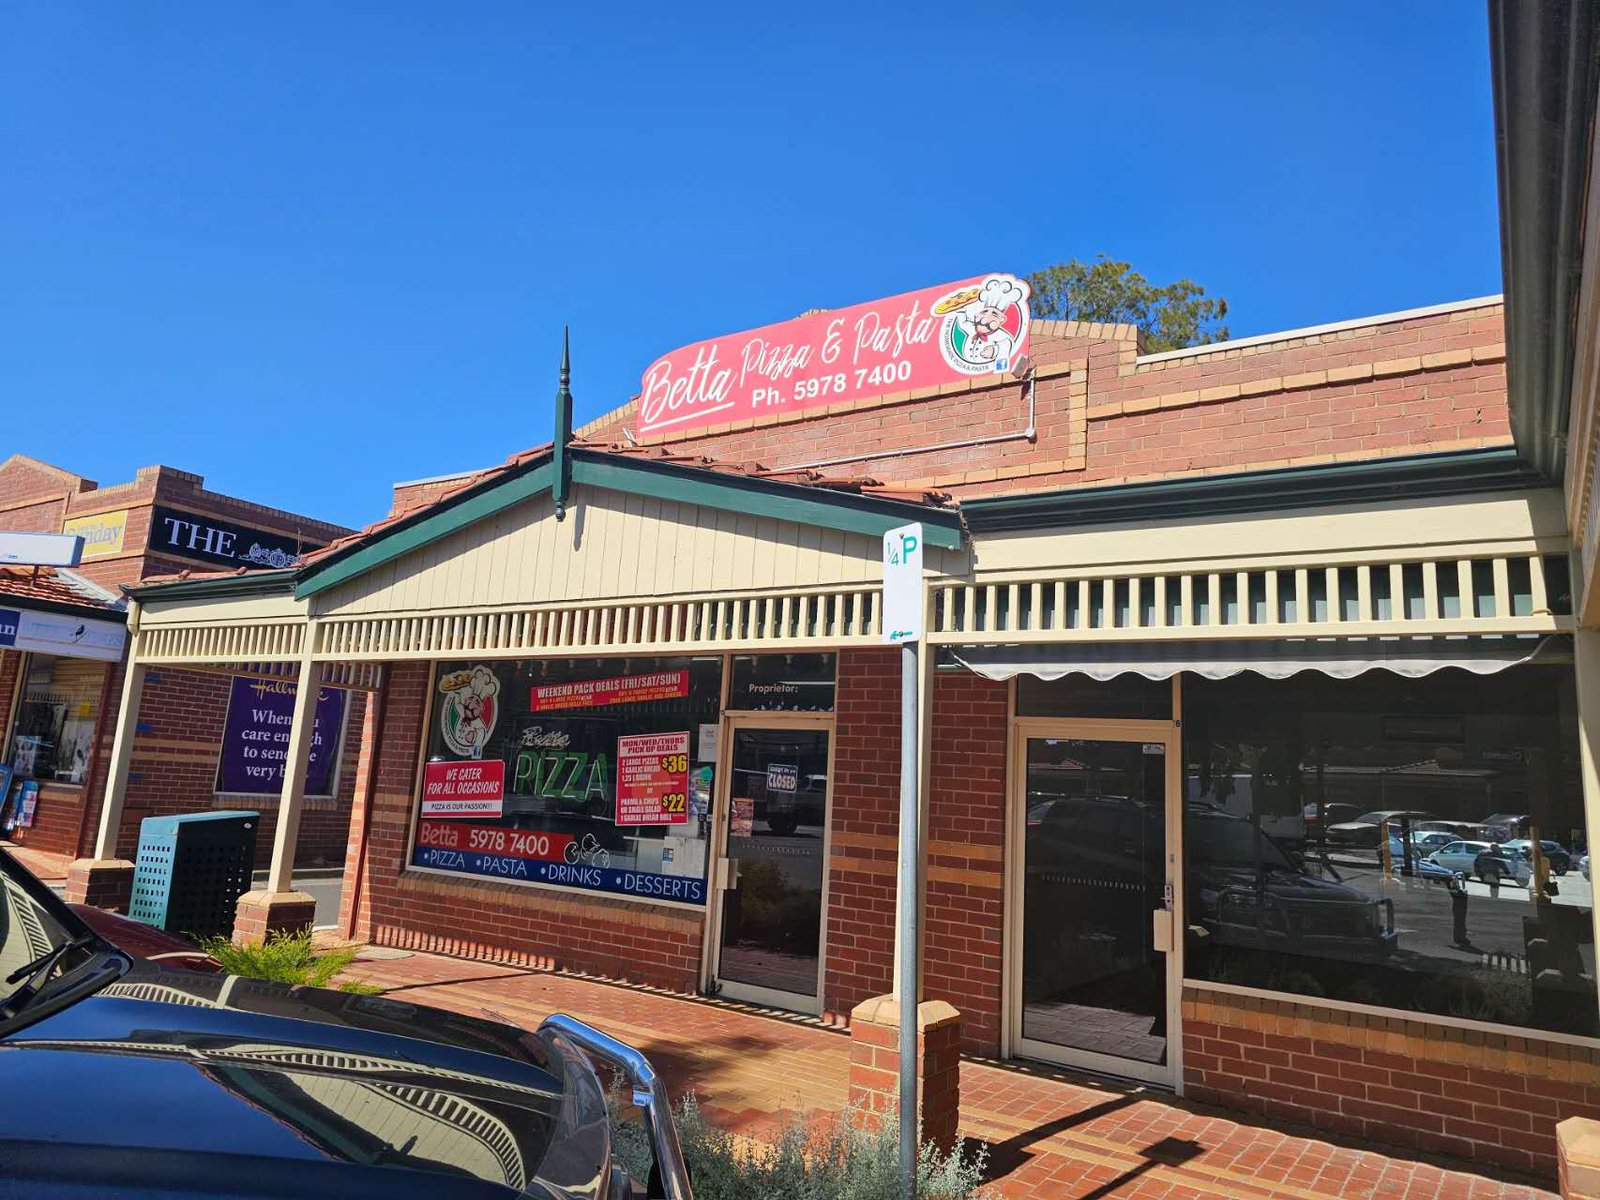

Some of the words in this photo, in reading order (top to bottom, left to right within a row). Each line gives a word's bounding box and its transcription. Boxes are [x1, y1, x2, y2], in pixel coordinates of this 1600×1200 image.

[640, 343, 738, 423] Betta
[740, 338, 815, 388] Pizza
[821, 317, 846, 362] &
[853, 300, 939, 365] Pasta
[751, 387, 785, 408] Ph.
[794, 374, 848, 401] 5978
[854, 360, 913, 389] 7400
[164, 517, 237, 558] THE
[537, 685, 573, 699] WEEKEND
[574, 682, 594, 695] PACK
[595, 679, 620, 692] DEALS
[749, 683, 799, 695] Proprietor:
[252, 709, 293, 725] When
[242, 730, 271, 741] care
[243, 746, 258, 758] to
[628, 746, 645, 754] PICK
[656, 744, 679, 752] DEALS
[662, 754, 687, 773] $36
[246, 765, 277, 781] very
[446, 768, 459, 781] WE
[459, 767, 482, 780] CATER
[513, 749, 608, 802] PIZZA
[768, 773, 796, 790] CLOSED
[427, 783, 443, 795] FOR
[443, 782, 456, 794] ALL
[457, 781, 500, 794] OCCASIONS
[662, 793, 685, 812] $22
[420, 823, 459, 847] Betta
[468, 829, 505, 851] 5978
[510, 833, 549, 856] 7400
[430, 850, 466, 869] PIZZA
[483, 856, 527, 876] PASTA
[548, 864, 601, 886] DRINKS
[624, 874, 701, 899] DESSERTS
